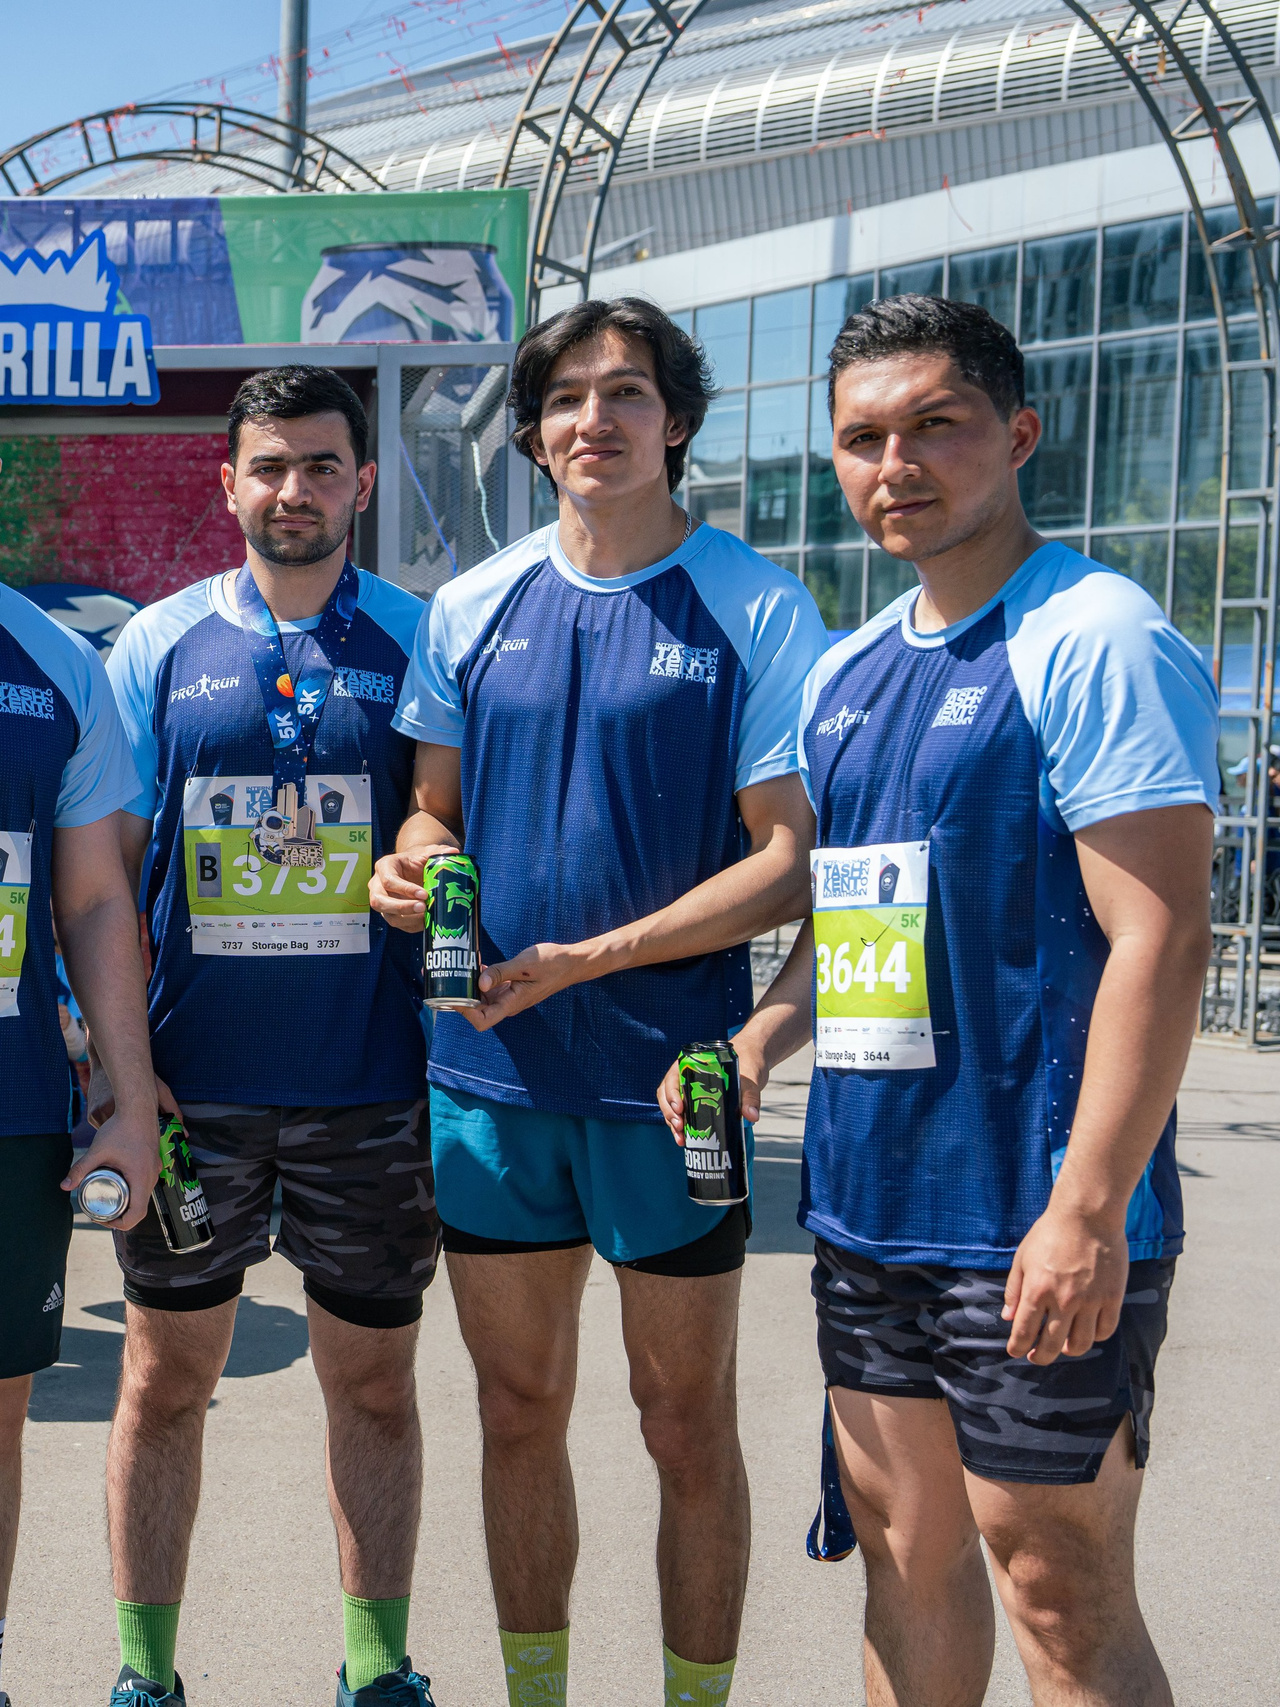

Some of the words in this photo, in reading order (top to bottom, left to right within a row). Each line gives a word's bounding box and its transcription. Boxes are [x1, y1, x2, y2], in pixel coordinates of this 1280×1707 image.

[500, 639, 530, 652] RUN
[650, 656, 708, 677] KENT
[654, 646, 712, 668] TASH
[170, 684, 196, 703] PRO
[210, 675, 240, 691] RUN
[333, 678, 384, 697] KENT
[334, 670, 387, 691] TASH
[297, 688, 321, 716] 5K
[274, 710, 297, 739] 5K
[349, 831, 368, 843] 5K
[199, 855, 218, 882] B
[823, 862, 861, 881] TASH
[823, 876, 860, 894] KENT
[823, 888, 862, 899] MARATHON
[9, 892, 26, 905] 5K
[900, 913, 921, 929] 5K
[221, 941, 243, 950] 3737
[252, 941, 289, 951] Storage
[290, 940, 309, 951] Bag
[316, 939, 341, 949] 3737
[425, 949, 478, 971] GORILLA
[816, 940, 912, 995] 3644
[430, 970, 454, 979] ENERGY
[453, 970, 472, 979] DRINK
[824, 1050, 844, 1063] Storage
[844, 1050, 856, 1063] Bag
[863, 1051, 891, 1062] 3644
[684, 1148, 733, 1171] ORILLA
[704, 1172, 726, 1180] DRINK
